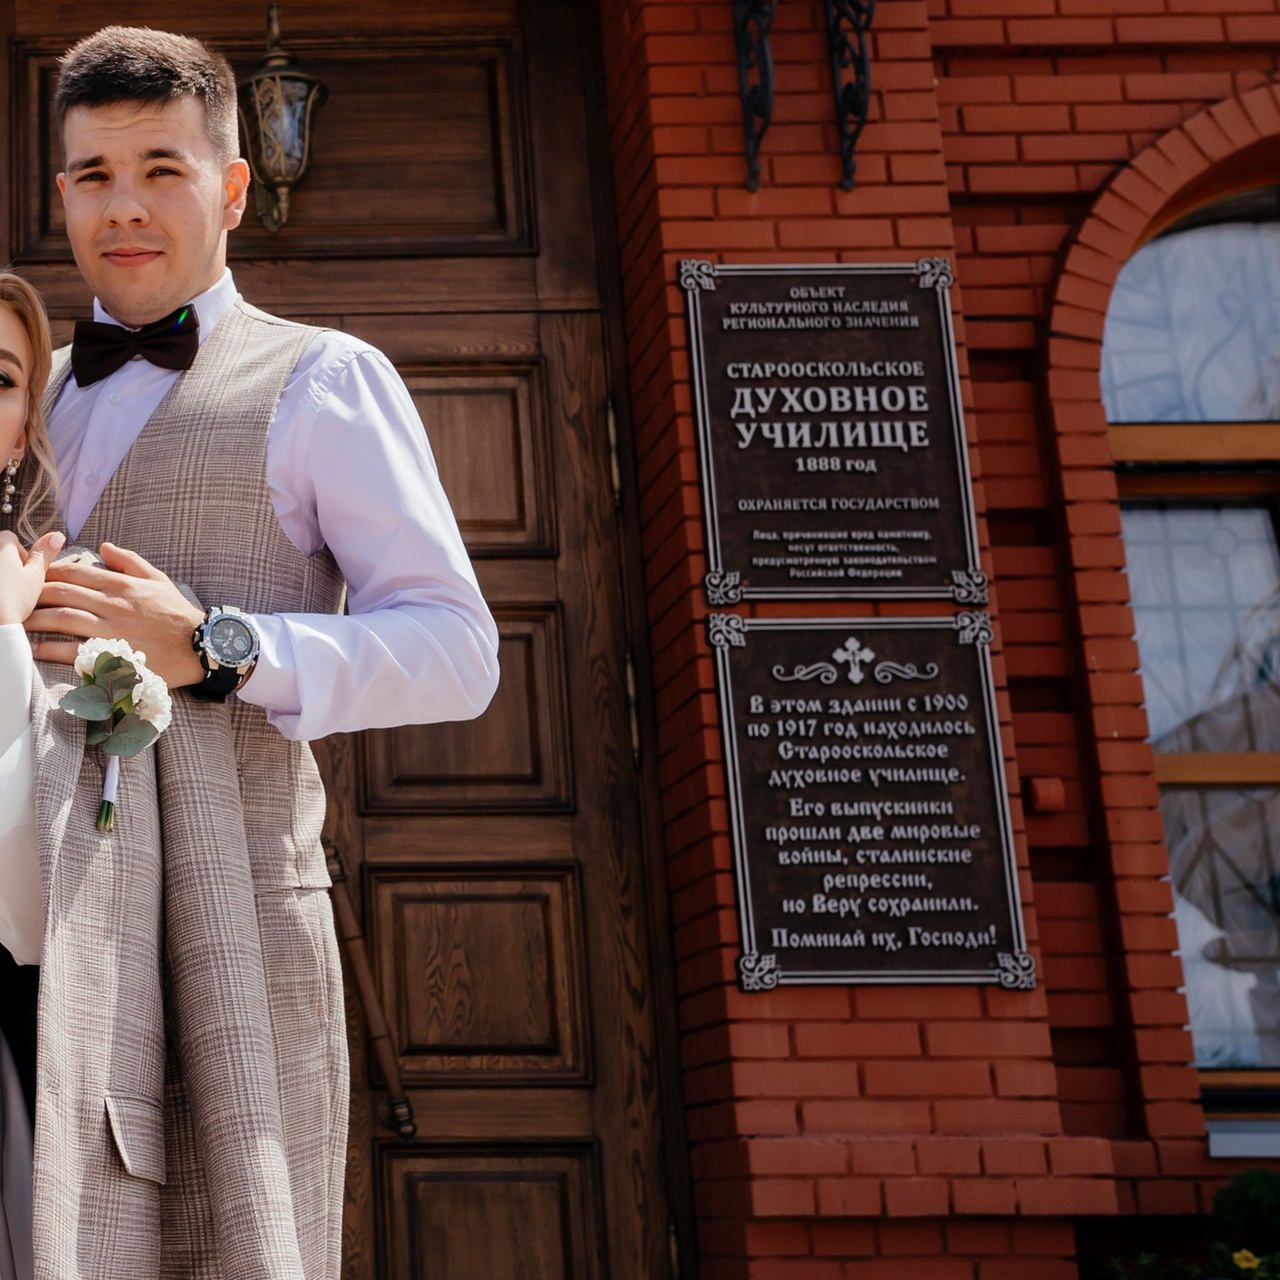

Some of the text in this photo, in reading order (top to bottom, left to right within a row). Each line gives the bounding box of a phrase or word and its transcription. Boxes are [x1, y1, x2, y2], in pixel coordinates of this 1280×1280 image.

[790, 286, 845, 299] ОБЪЕКТ
[730, 300, 908, 315] КУЛЬТУРНОГО НАСЛЕДИЯ
[723, 316, 919, 330] РЕГИОНАЛЬНОГО ЗНАЧЕНИЯ
[726, 361, 925, 379] СТАРООСКОЛЬСКОЕ
[730, 386, 929, 419] ДУХОВНОЕ
[735, 421, 930, 452] УЧИЛИЩЕ
[795, 457, 877, 473] 1888 год
[738, 497, 940, 511] ОХРАНЯЕТСЯ ГОСУДАРСТВОМ
[750, 694, 968, 715] В этом здании с 1900
[747, 719, 975, 739] по 1917 год находилось
[778, 741, 949, 764] Старооскольское
[768, 768, 966, 788] духовное училище.
[789, 798, 954, 821] Его выпускники
[766, 824, 981, 845] прошли две мировые
[778, 847, 973, 866] войны, сталинские
[823, 873, 933, 892] репрессии,
[782, 894, 979, 917] но Веру сохранили.
[770, 925, 997, 951] Поминай их, Господи!
